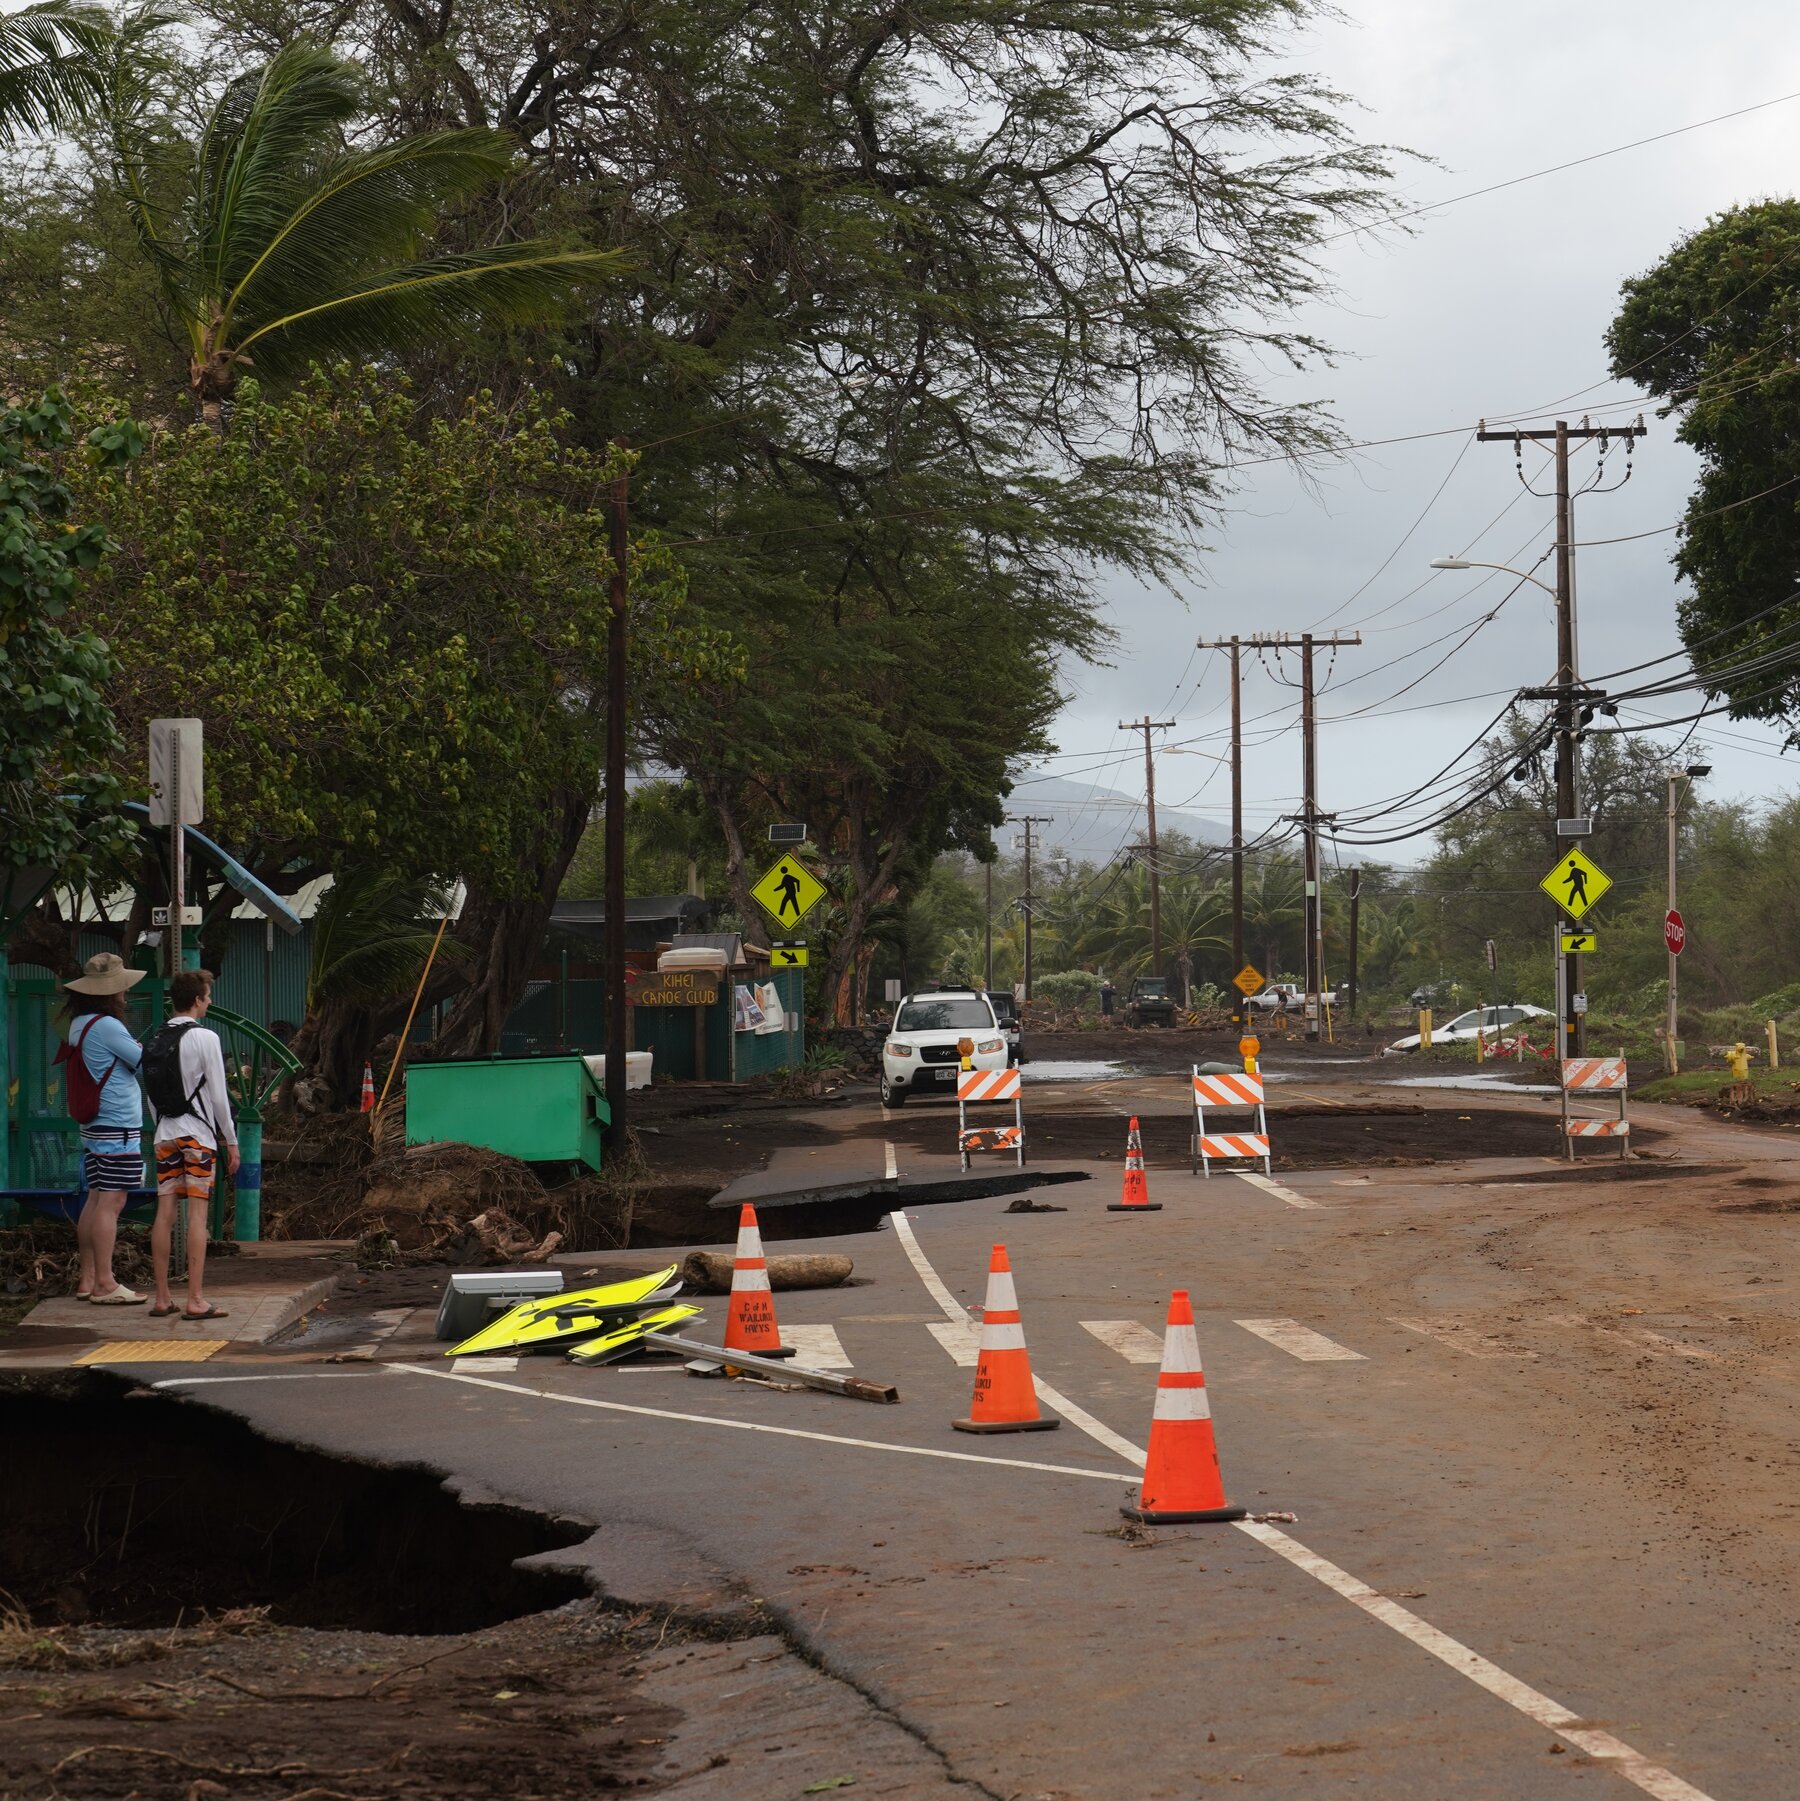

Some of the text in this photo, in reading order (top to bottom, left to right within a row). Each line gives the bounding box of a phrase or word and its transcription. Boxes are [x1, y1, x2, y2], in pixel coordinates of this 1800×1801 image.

[1666, 921, 1684, 943] STOP
[663, 974, 694, 988] KIHEI
[641, 990, 716, 1004] CANOE CLUB
[744, 1302, 750, 1312] C
[744, 1324, 770, 1334] HWYS
